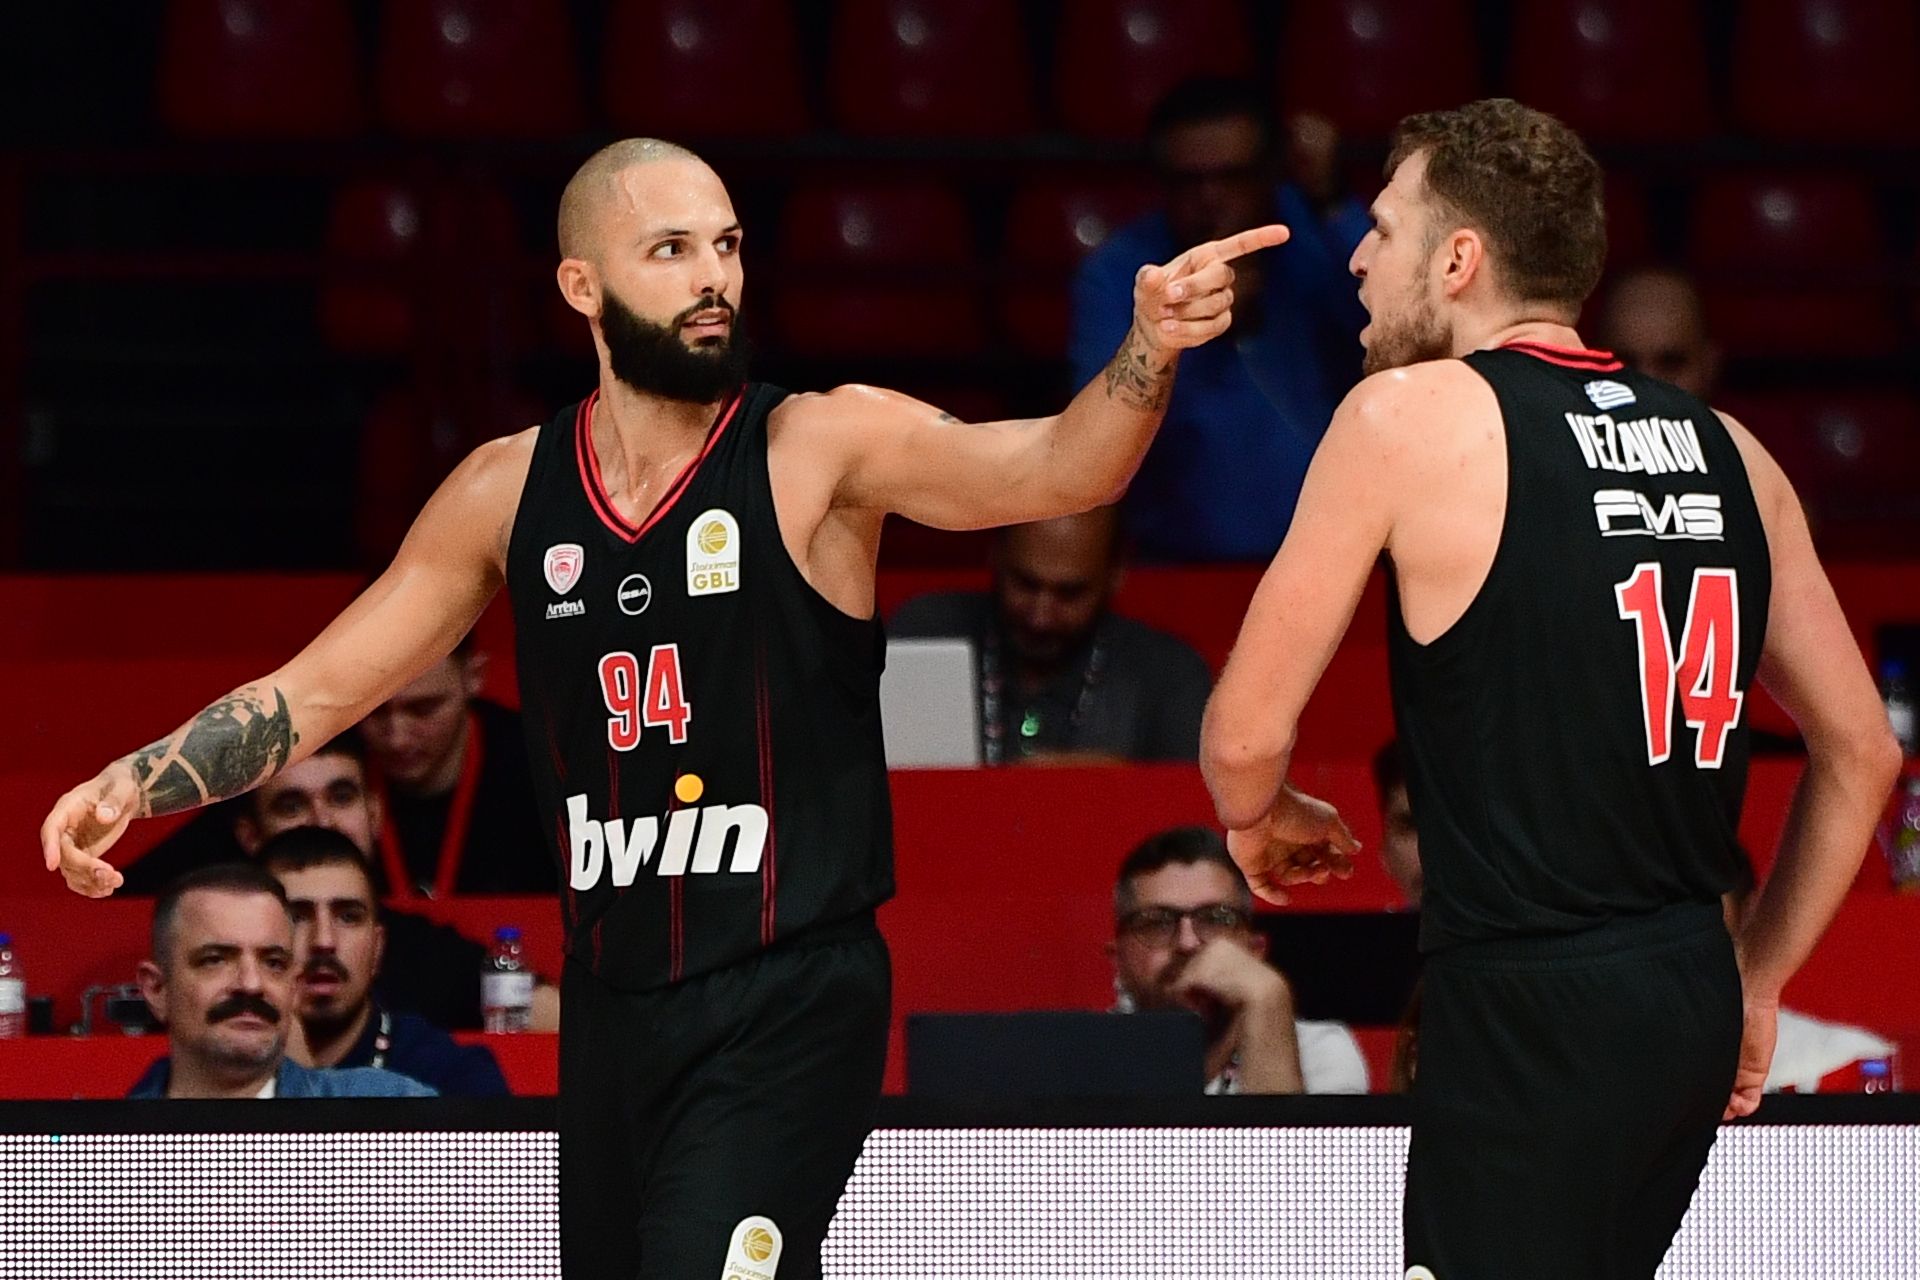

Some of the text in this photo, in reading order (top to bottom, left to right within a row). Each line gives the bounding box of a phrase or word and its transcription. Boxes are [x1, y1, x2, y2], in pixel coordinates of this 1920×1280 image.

[1593, 490, 1724, 541] FMS
[693, 571, 735, 590] GBL
[598, 643, 691, 751] 94
[1614, 562, 1743, 769] 14
[566, 773, 769, 891] bwin
